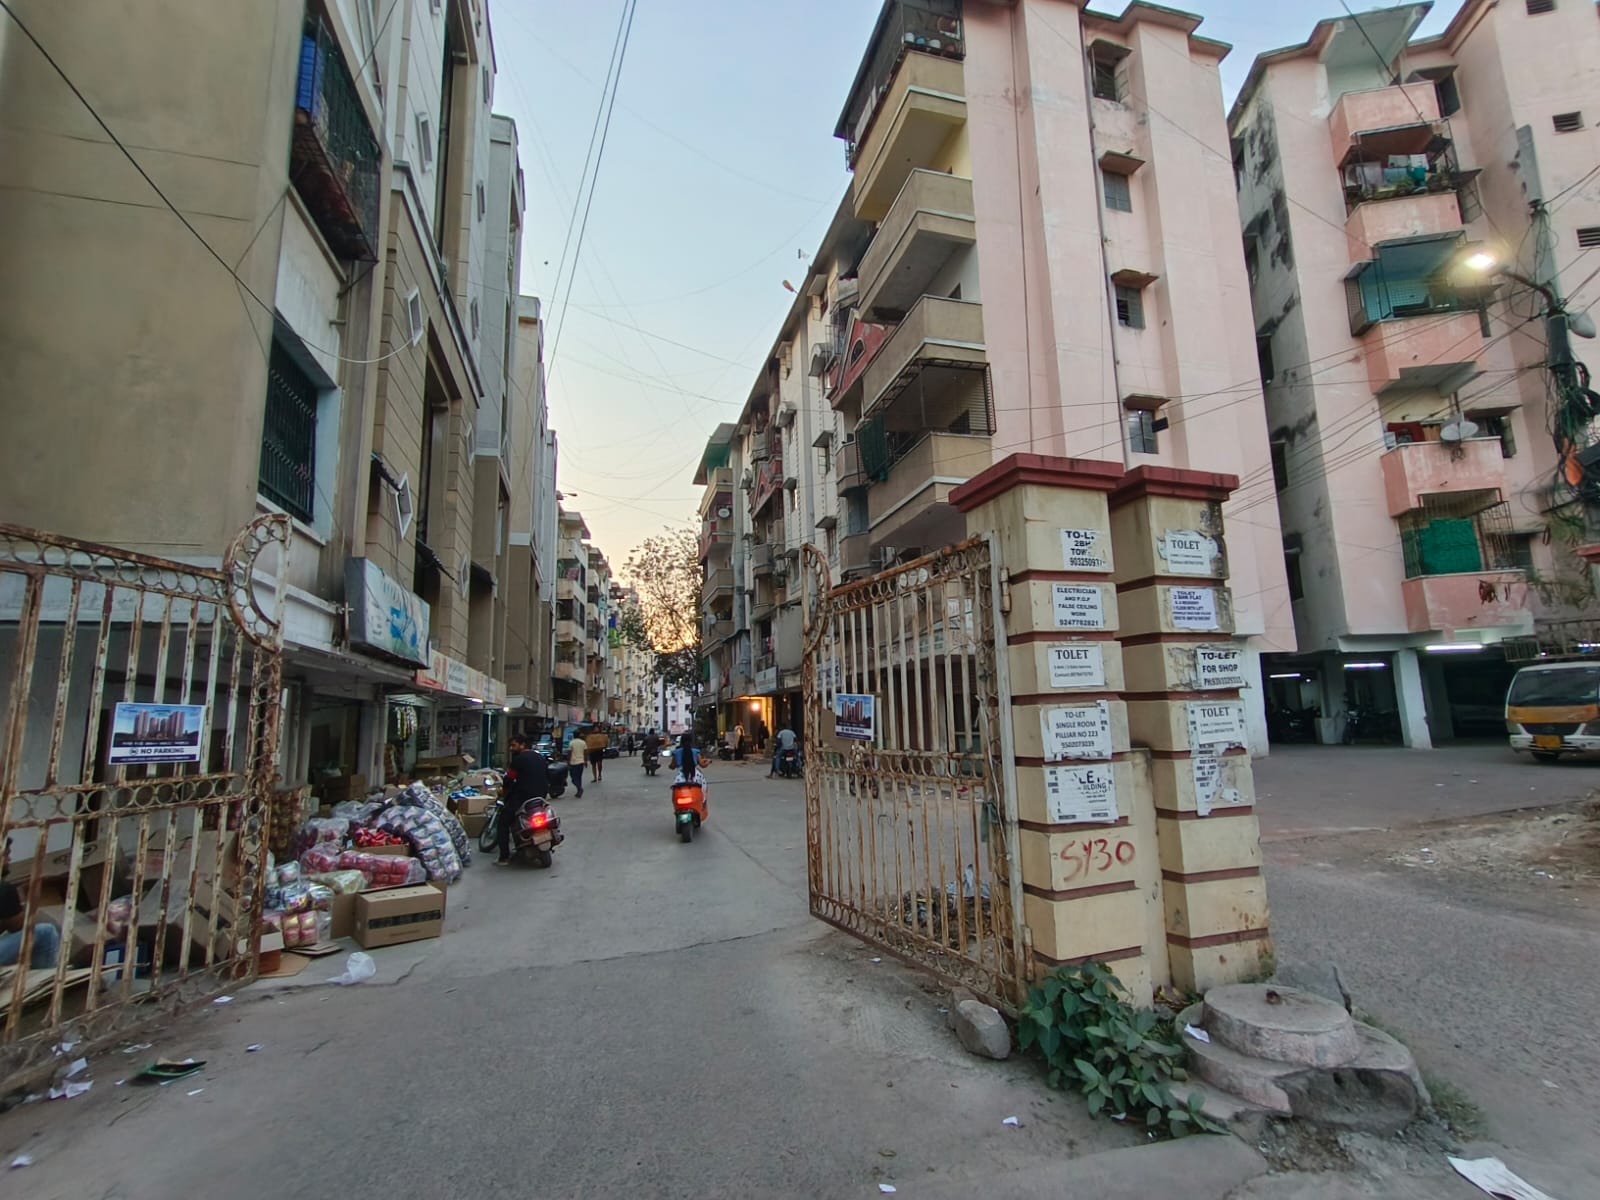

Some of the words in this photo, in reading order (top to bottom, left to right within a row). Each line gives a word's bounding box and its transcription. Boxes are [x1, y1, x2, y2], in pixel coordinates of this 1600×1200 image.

[1170, 539, 1200, 550] TOLET
[1055, 649, 1089, 660] TOLET
[1200, 651, 1238, 660] TO-LET
[1202, 665, 1217, 673] FOR
[1218, 663, 1238, 672] SHOP
[1064, 711, 1086, 719] TO-LET
[1200, 706, 1231, 718] TOLET
[1055, 721, 1076, 729] SINGLE
[1077, 720, 1096, 728] ROOM
